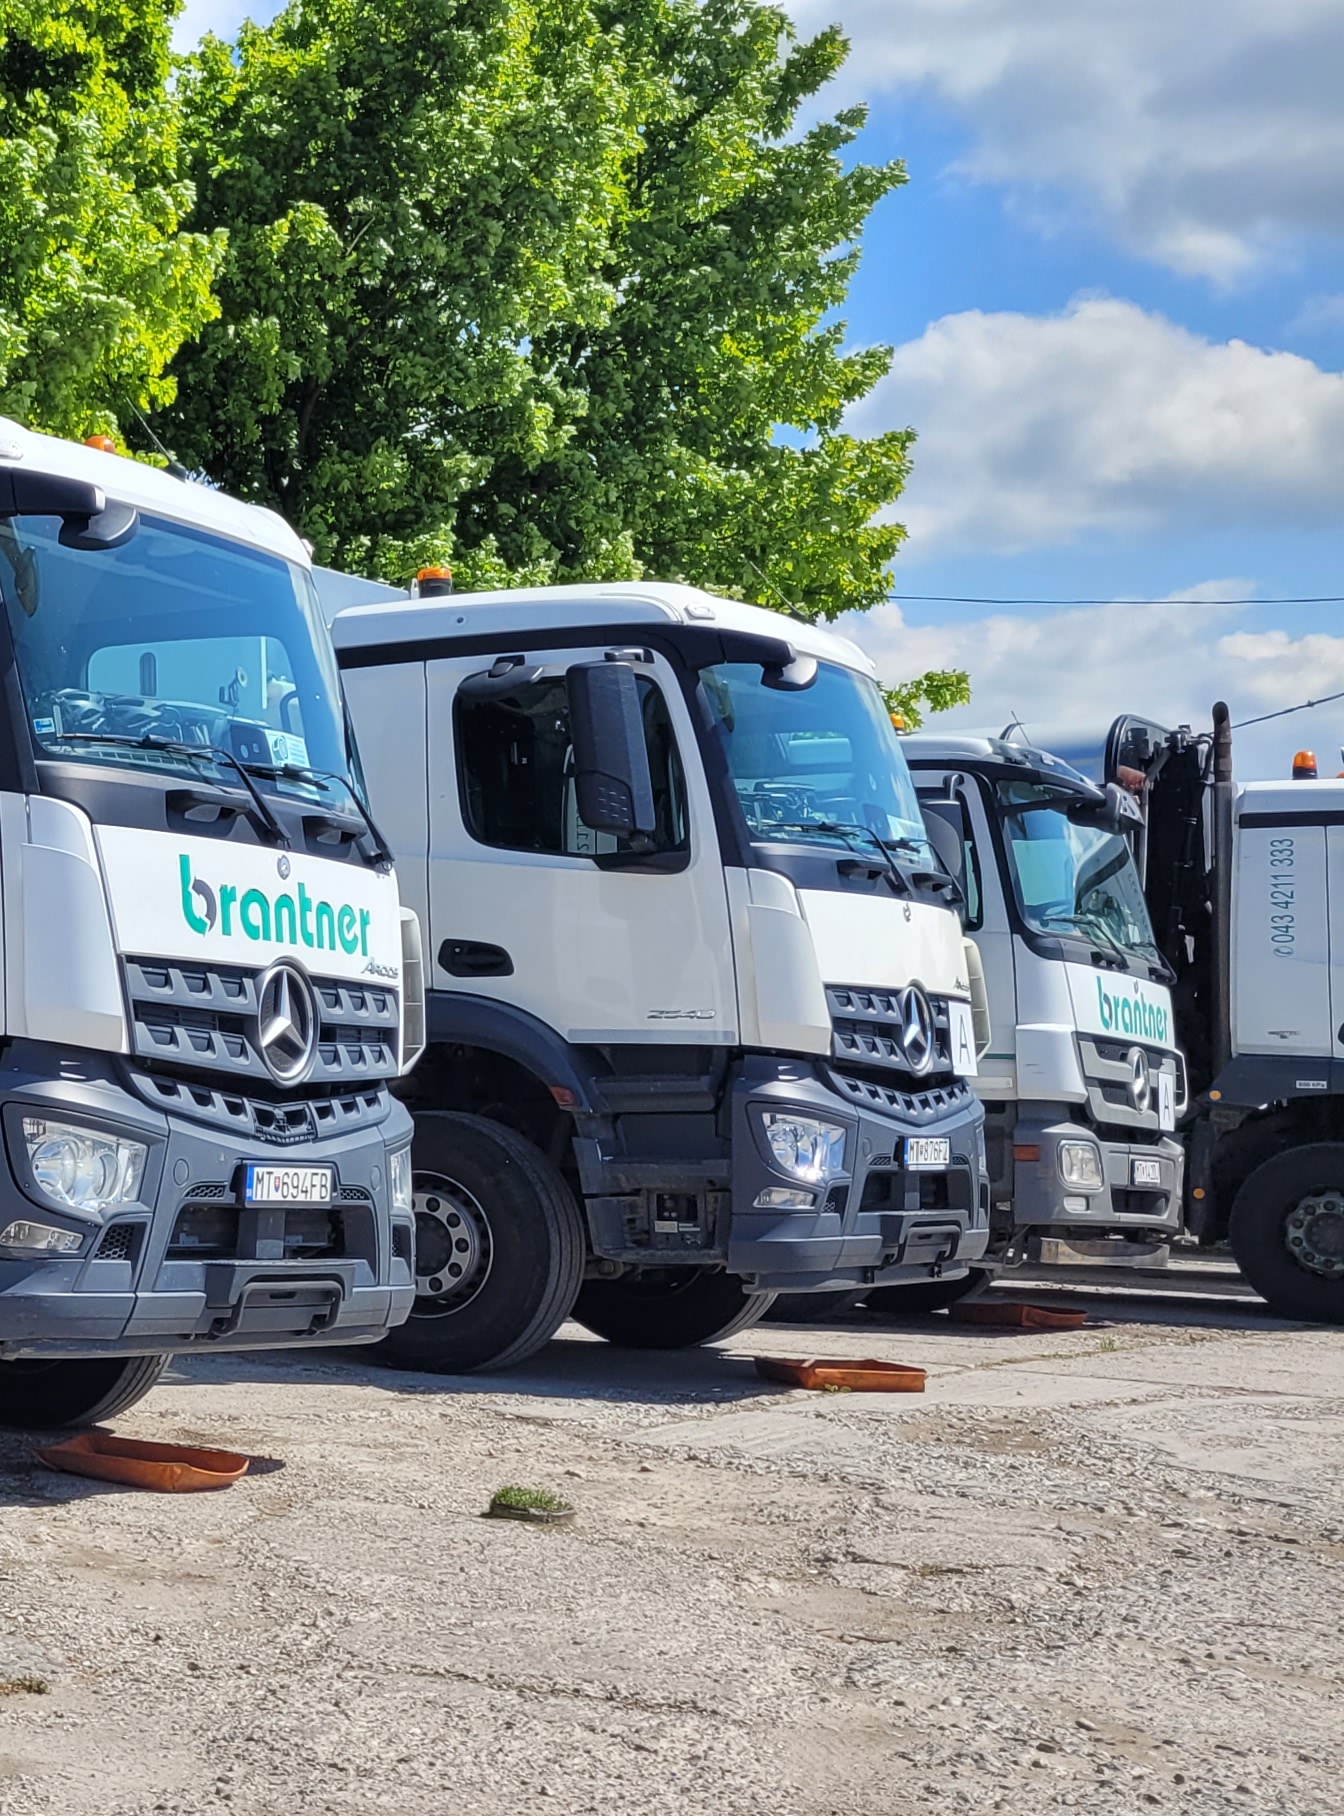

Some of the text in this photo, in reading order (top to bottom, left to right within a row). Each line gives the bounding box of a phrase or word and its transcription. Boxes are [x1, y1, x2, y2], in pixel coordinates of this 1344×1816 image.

[179, 854, 371, 957] brantner
[1270, 915, 1295, 944] 043
[1096, 976, 1167, 1043] brantner
[959, 1013, 971, 1065] A
[1162, 1082, 1171, 1122] A
[255, 1171, 274, 1199] MT
